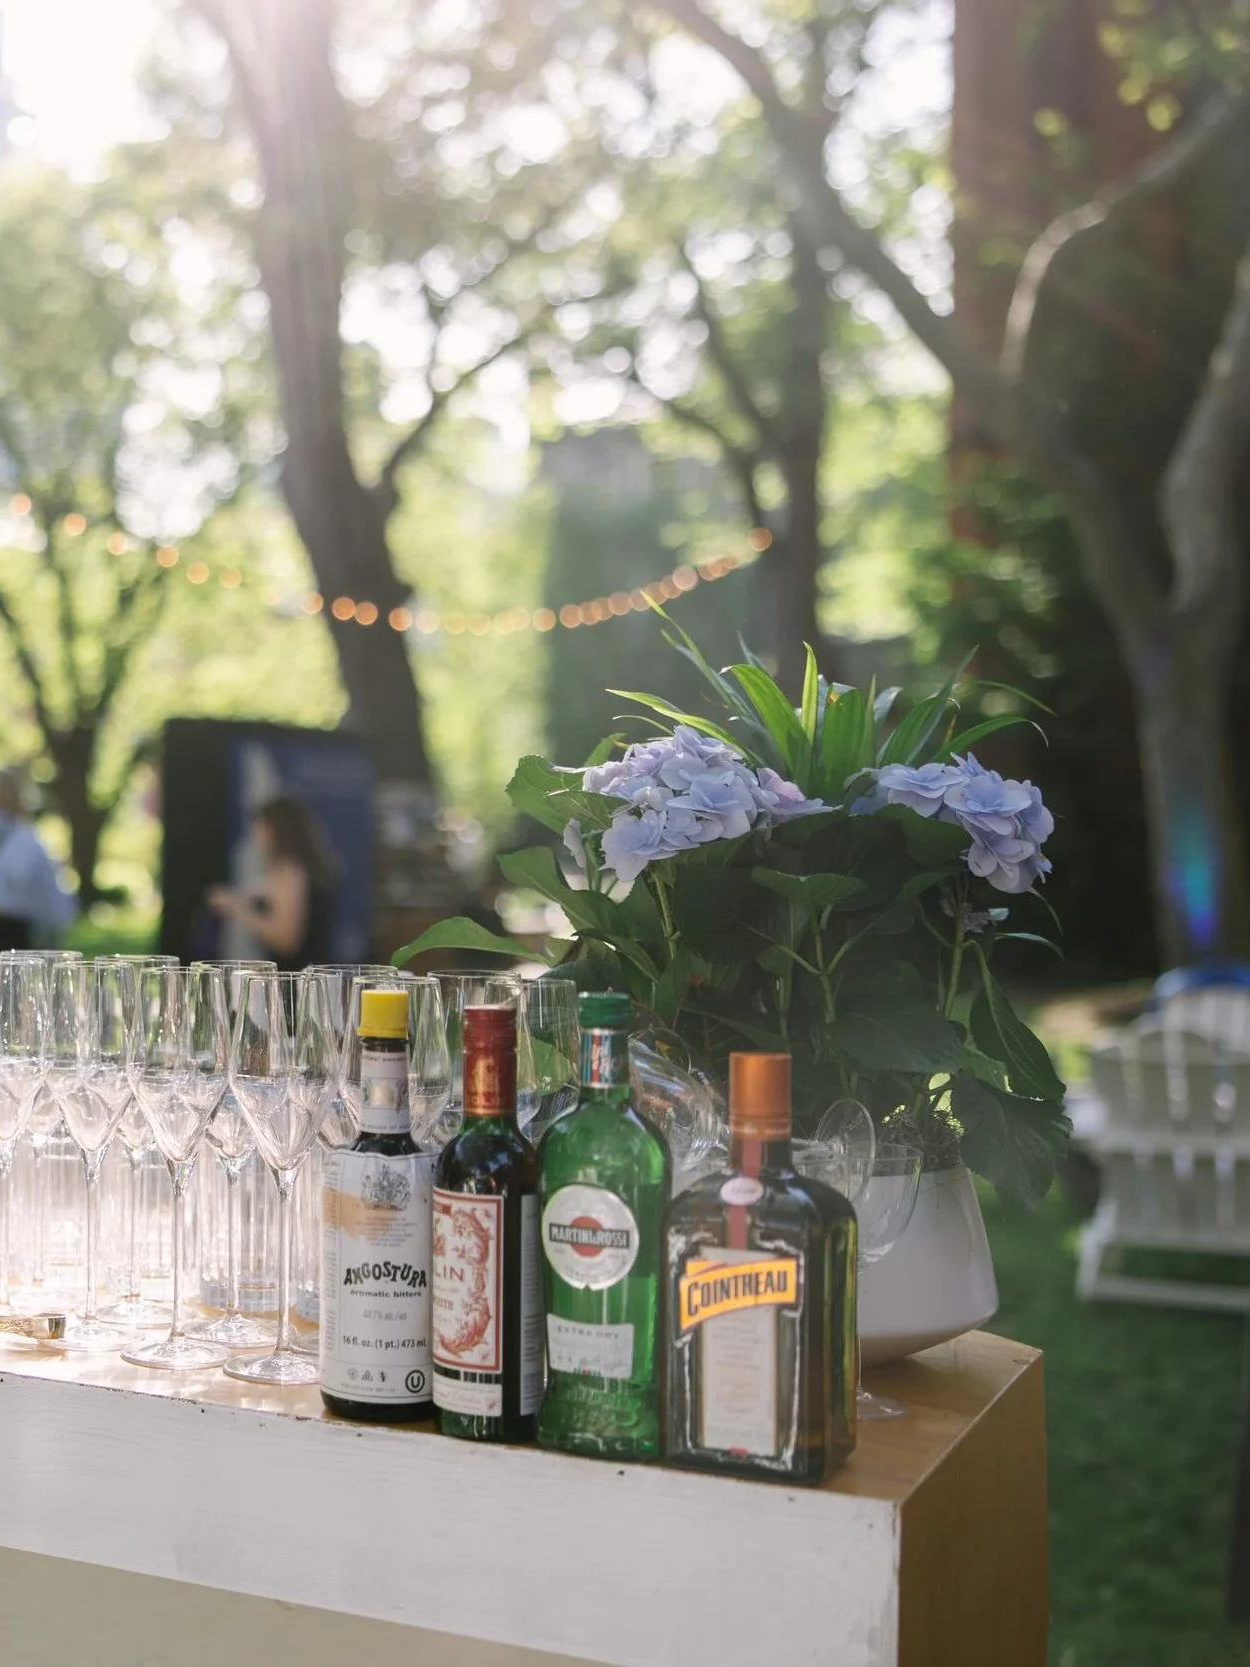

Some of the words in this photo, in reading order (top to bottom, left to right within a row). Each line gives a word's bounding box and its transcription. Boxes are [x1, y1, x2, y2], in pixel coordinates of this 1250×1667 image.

[343, 1261, 427, 1288] ANGOSTURA
[434, 1262, 464, 1283] LIN
[350, 1289, 390, 1298] aromatic
[393, 1290, 422, 1298] bitters
[687, 1270, 788, 1317] COINTREAU
[557, 1325, 593, 1336] EXTRA
[595, 1330, 619, 1339] DRY
[342, 1335, 351, 1345] 16
[375, 1338, 383, 1349] (1
[385, 1339, 400, 1351] pt.)
[401, 1339, 415, 1349] 473
